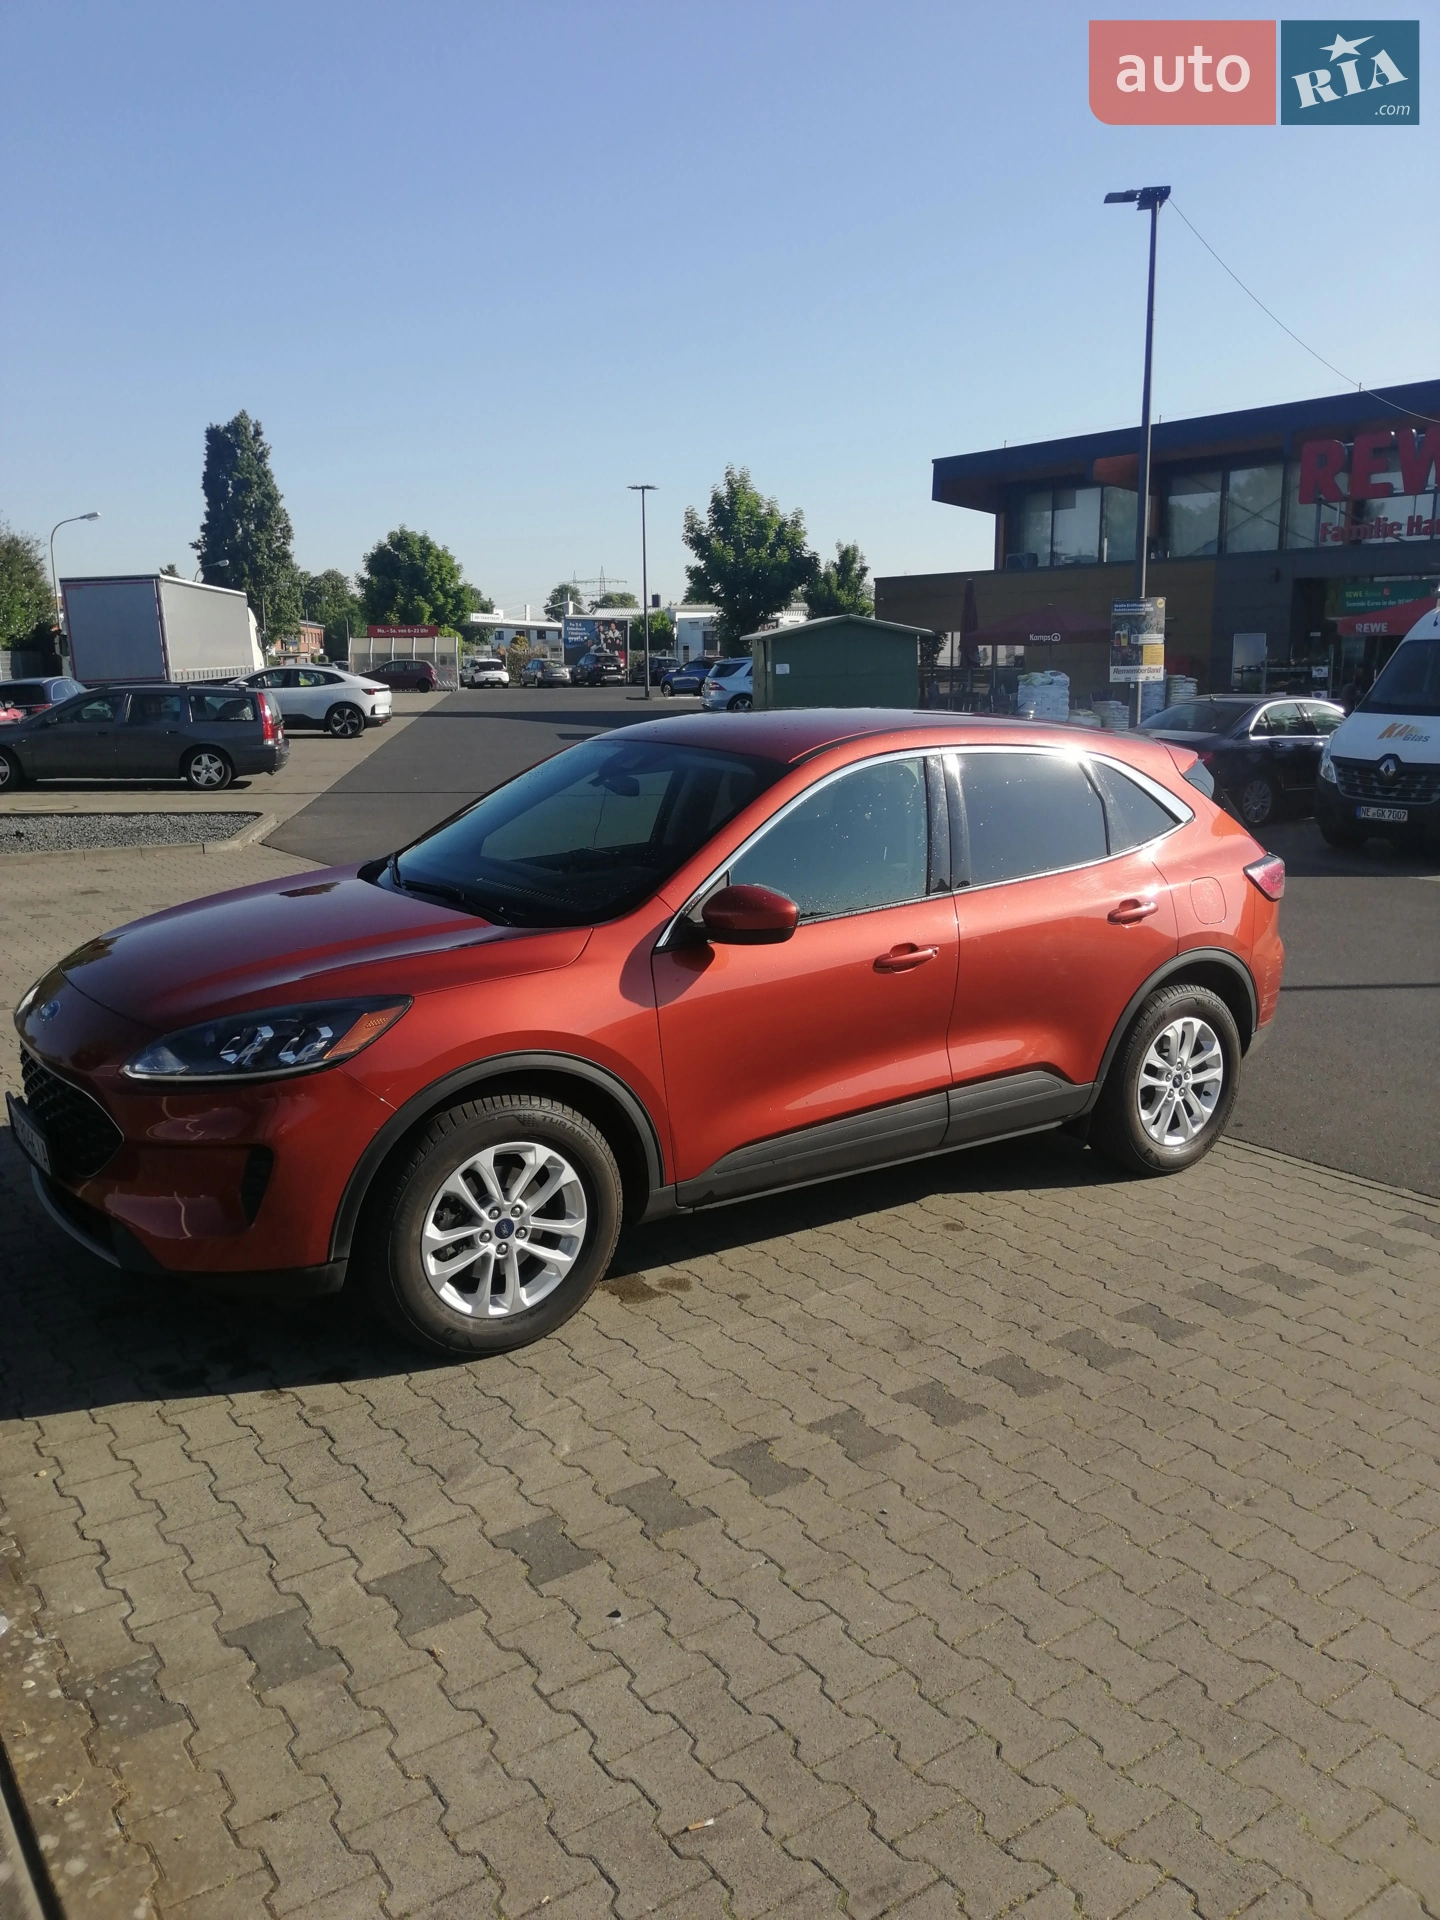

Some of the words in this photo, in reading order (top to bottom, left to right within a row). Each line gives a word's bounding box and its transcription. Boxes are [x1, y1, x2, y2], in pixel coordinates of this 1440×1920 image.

[1320, 516, 1402, 543] Familie
[1406, 515, 1440, 536] Ha
[1355, 623, 1388, 633] REWE
[1029, 634, 1051, 642] Kamps
[1403, 733, 1430, 743] Glas
[1387, 809, 1407, 820] 7007
